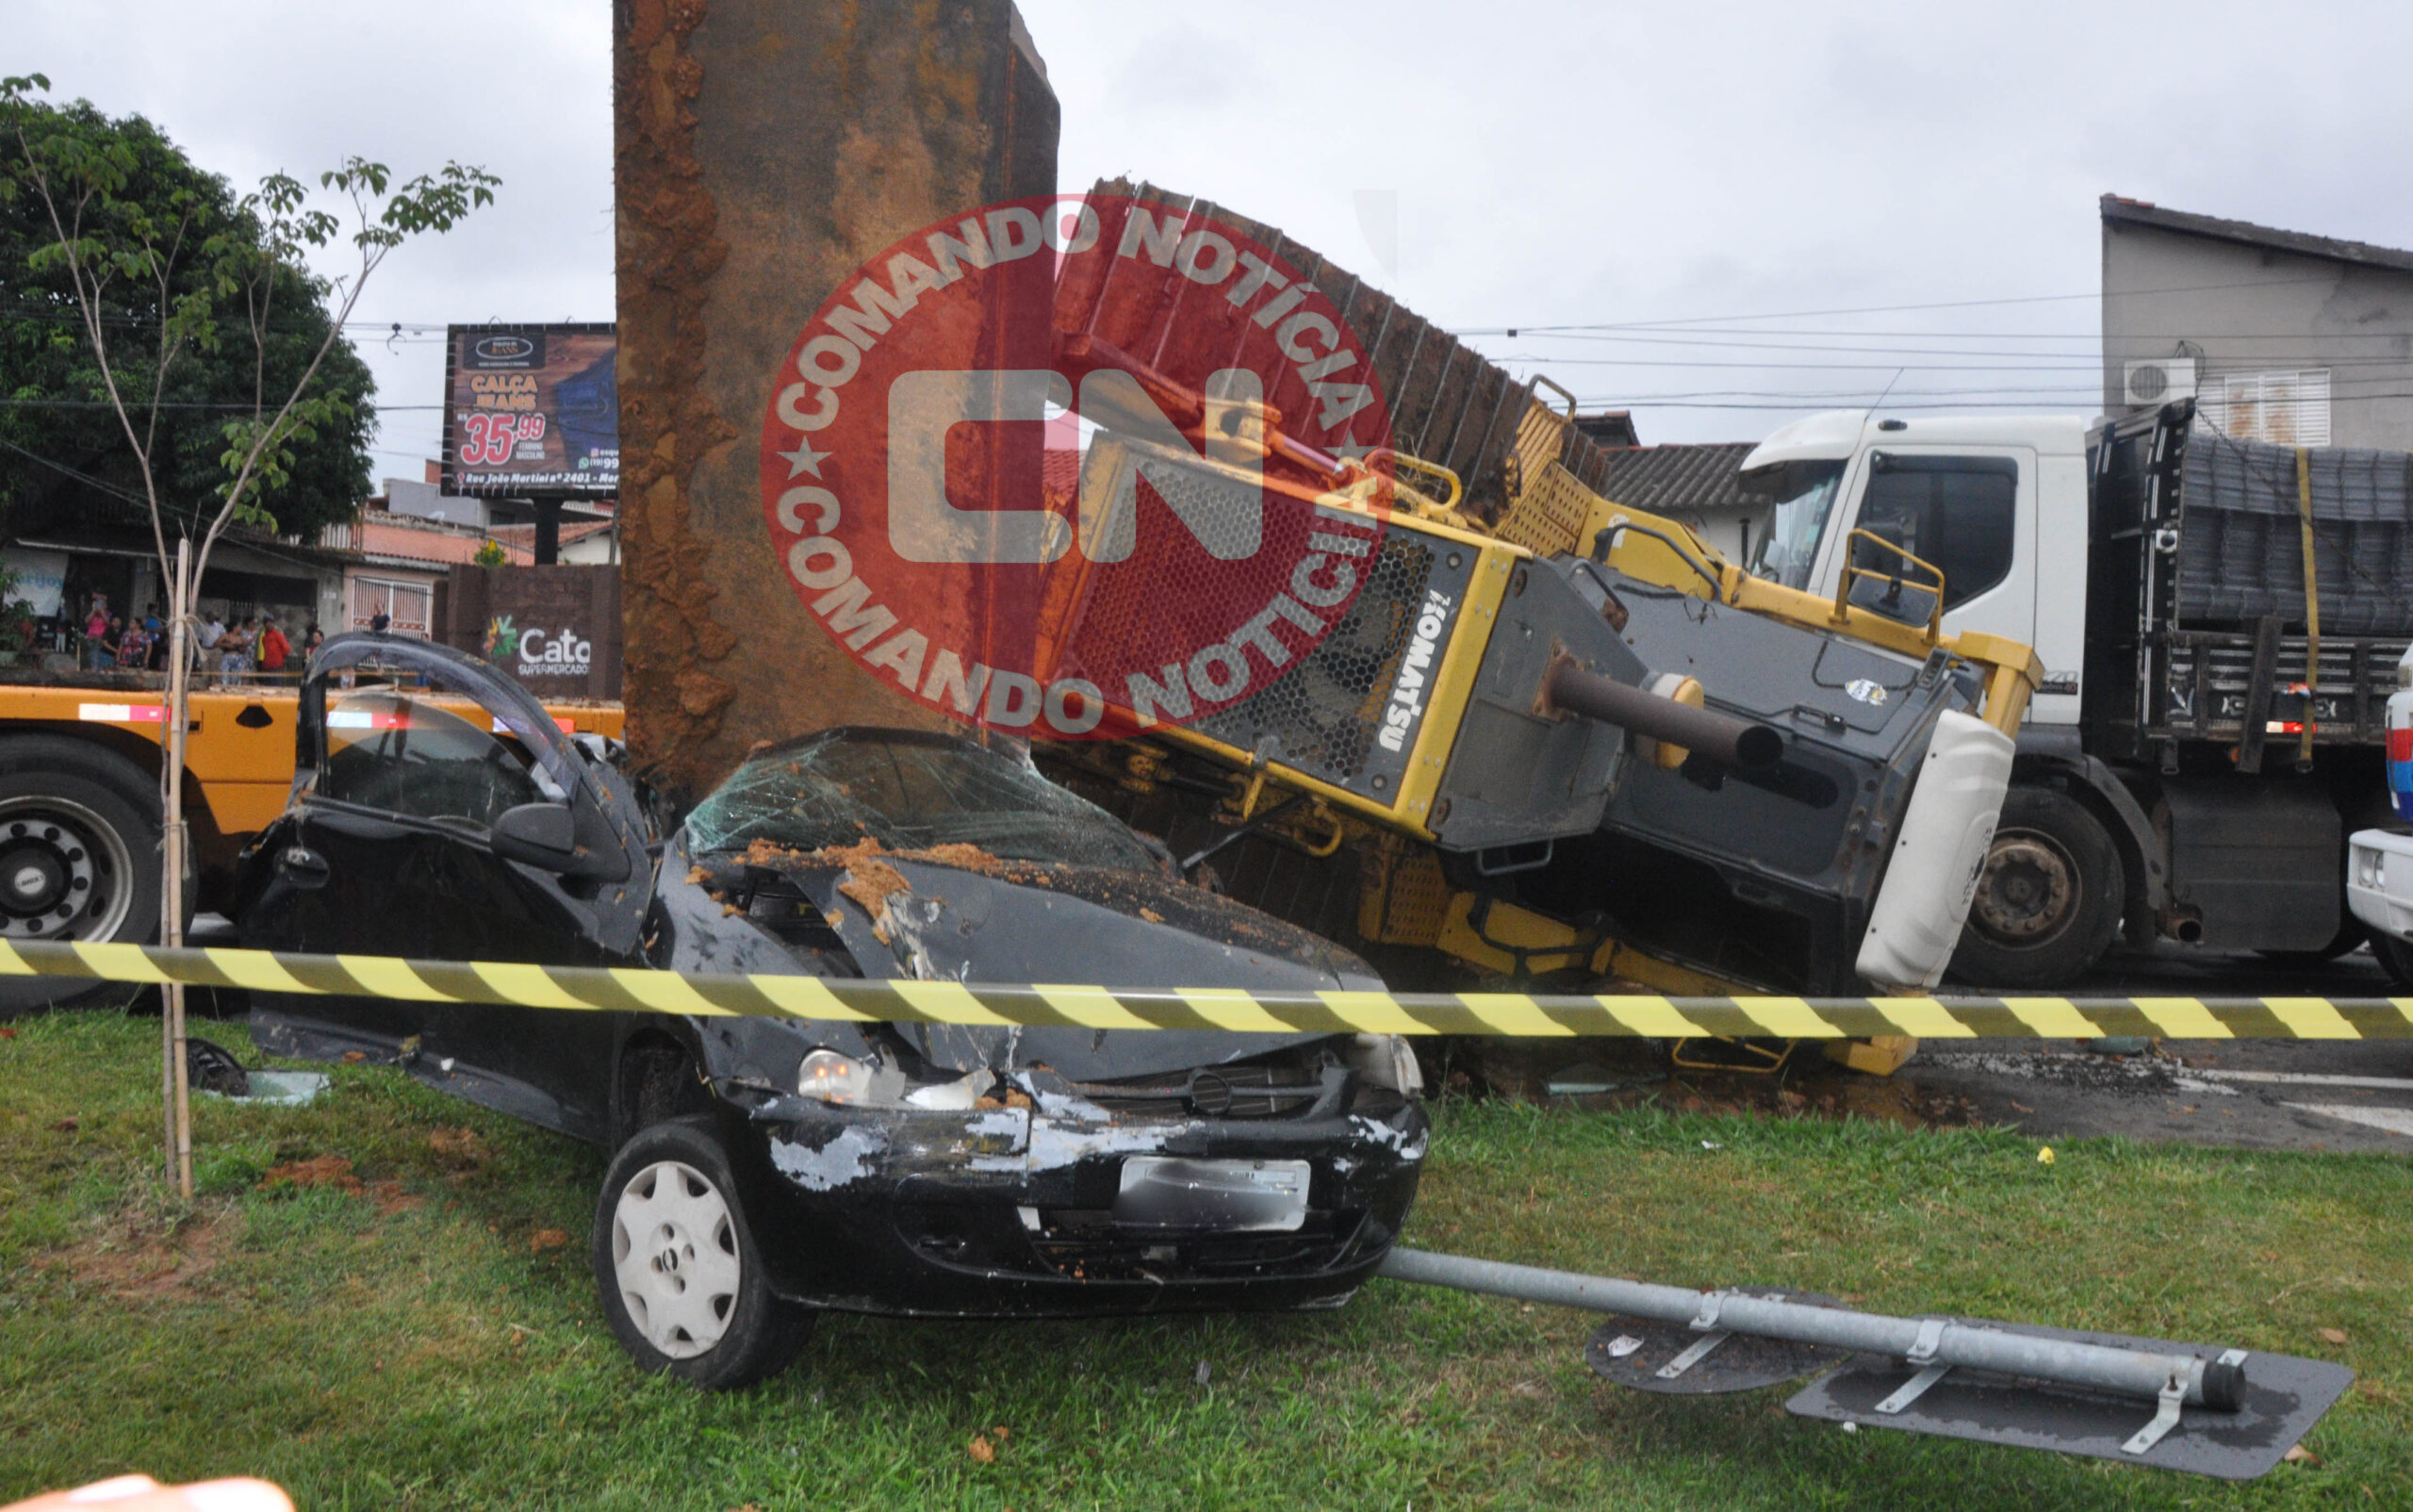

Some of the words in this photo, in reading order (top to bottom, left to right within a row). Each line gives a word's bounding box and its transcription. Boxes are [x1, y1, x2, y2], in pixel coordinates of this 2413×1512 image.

[471, 374, 538, 396] CALÇA
[473, 394, 536, 411] JEANS
[461, 413, 546, 466] 35,99
[466, 473, 484, 484] Rua
[485, 473, 509, 485] João
[510, 473, 549, 484] Martini
[564, 473, 591, 484] 2401
[518, 664, 590, 675] SUPERMERCADO
[1379, 589, 1451, 752] KOMATSU
